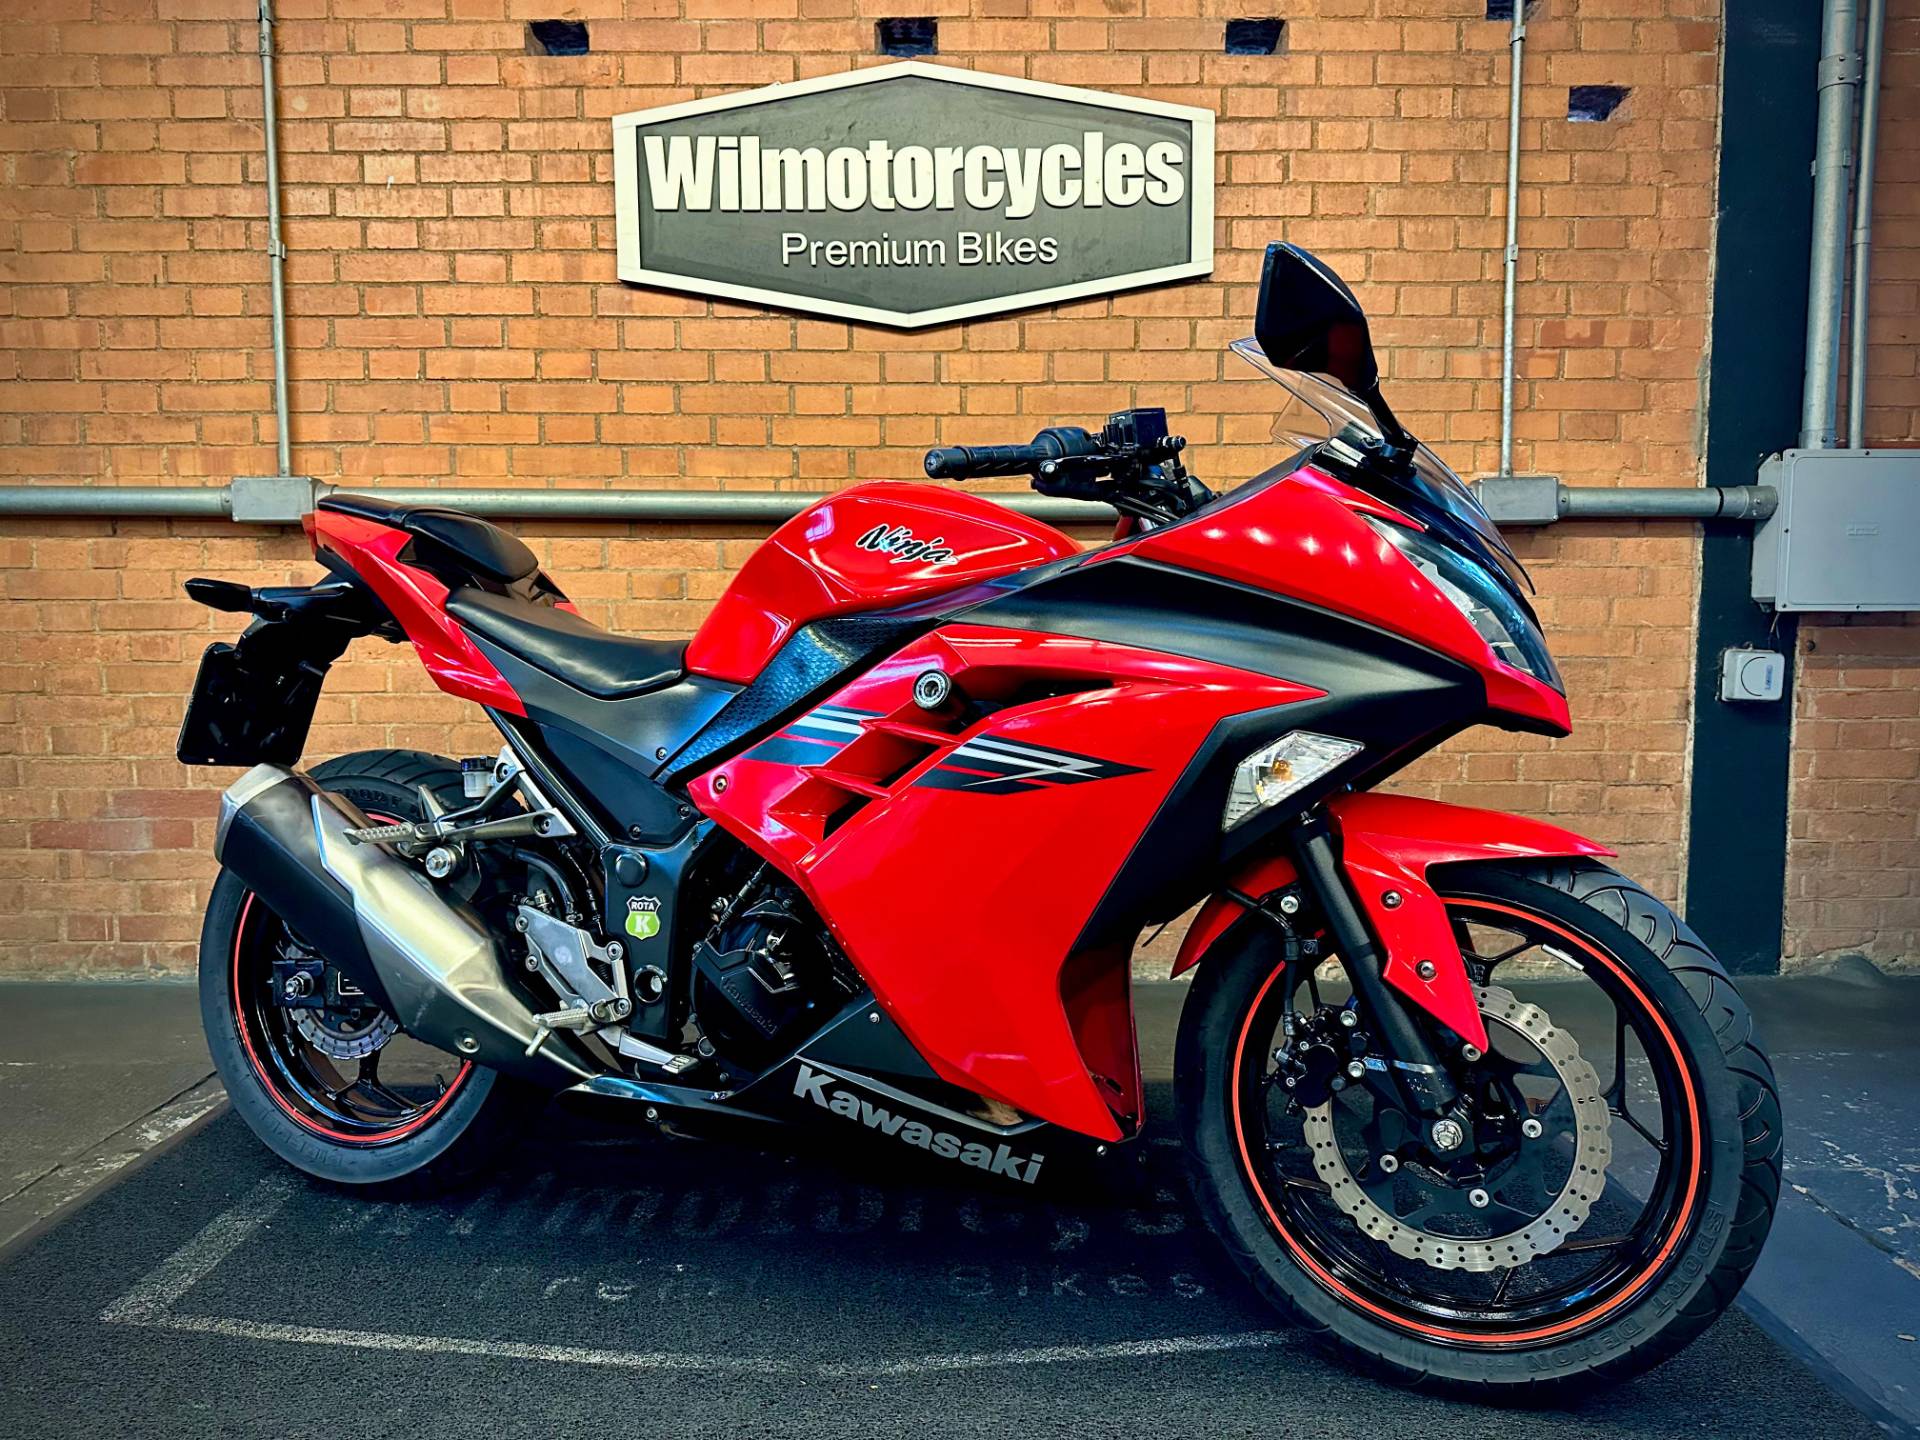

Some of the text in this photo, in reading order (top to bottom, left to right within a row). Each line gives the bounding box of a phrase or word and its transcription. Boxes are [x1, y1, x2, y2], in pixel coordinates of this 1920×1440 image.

[642, 131, 1186, 219] Wilmotorcycles
[781, 232, 947, 267] Premium
[856, 524, 958, 565] Ninja
[631, 901, 655, 911] ROTA
[635, 914, 652, 933] K
[792, 1064, 1046, 1185] Kawasaki
[1651, 1207, 1726, 1318] SPORT
